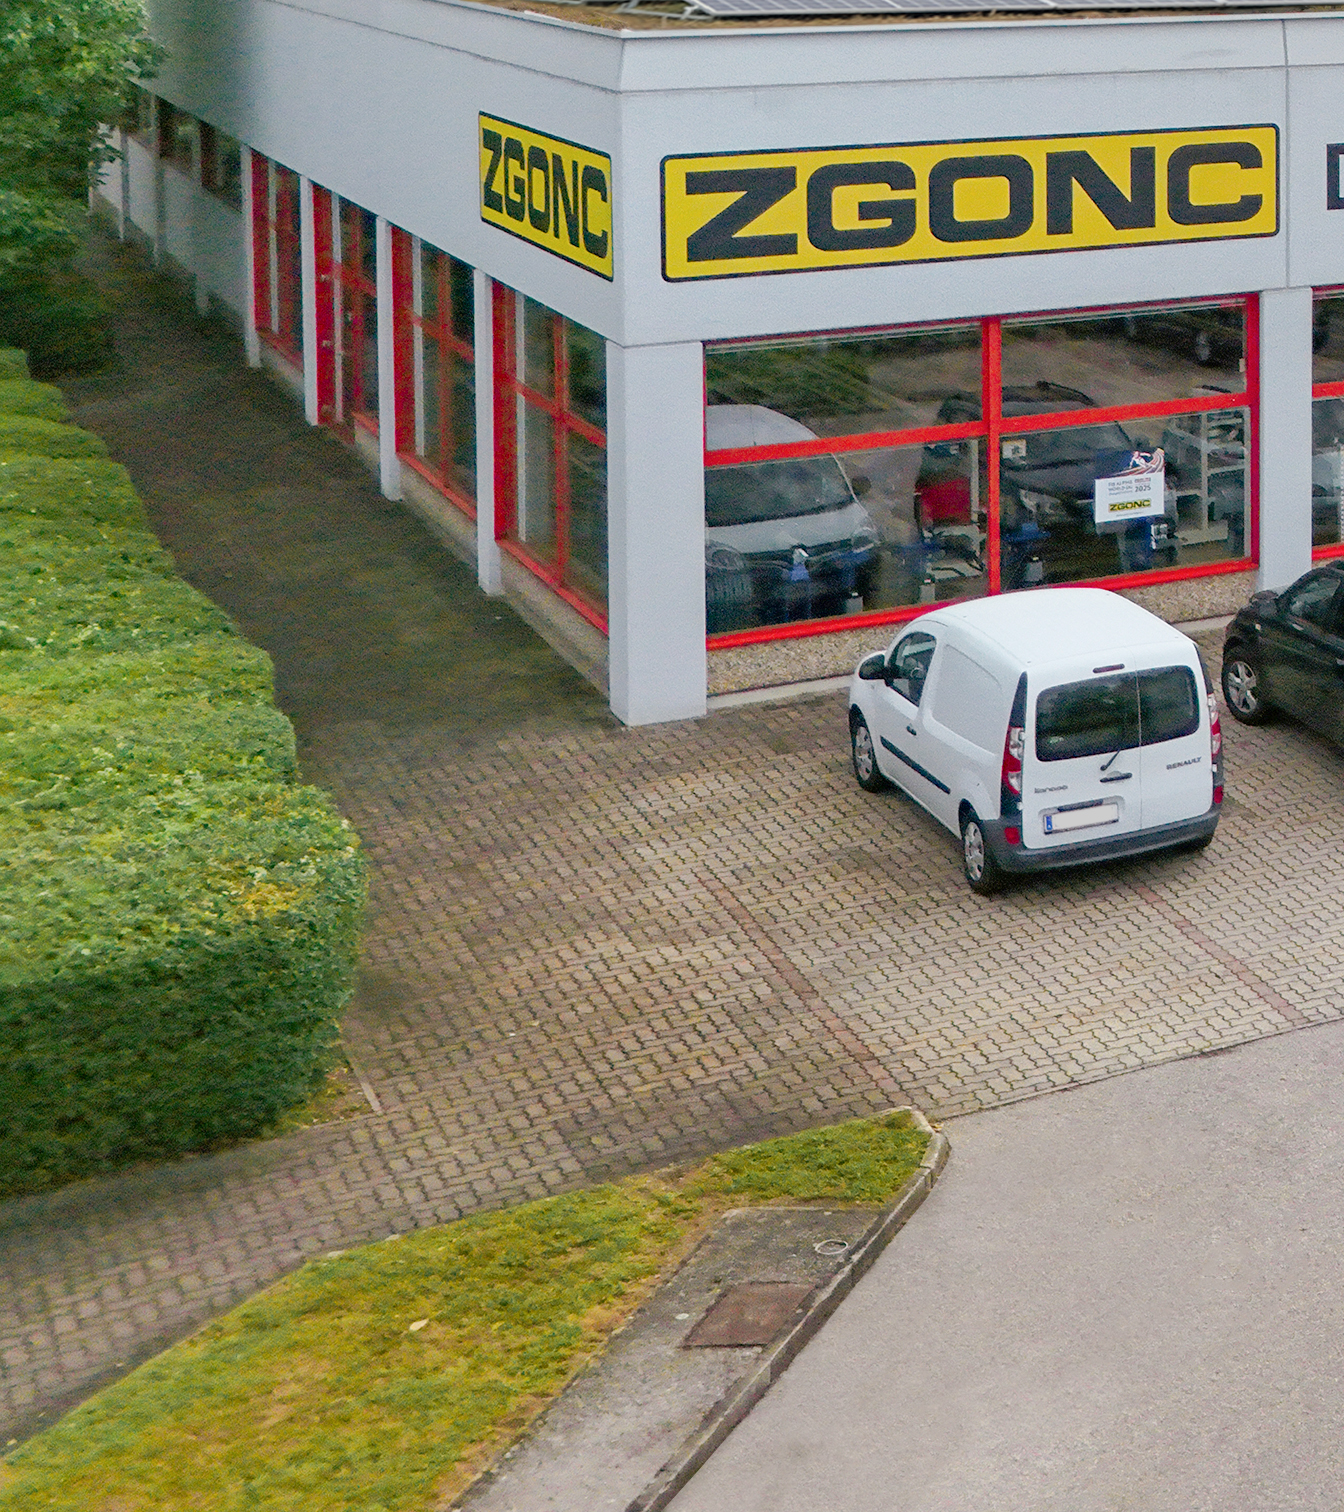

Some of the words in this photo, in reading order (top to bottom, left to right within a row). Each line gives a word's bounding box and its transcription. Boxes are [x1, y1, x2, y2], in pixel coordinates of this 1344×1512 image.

[482, 130, 608, 258] ZGONC
[686, 142, 1263, 262] ZGONC
[1109, 499, 1151, 511] ZGONC
[1166, 756, 1202, 770] RENAULT
